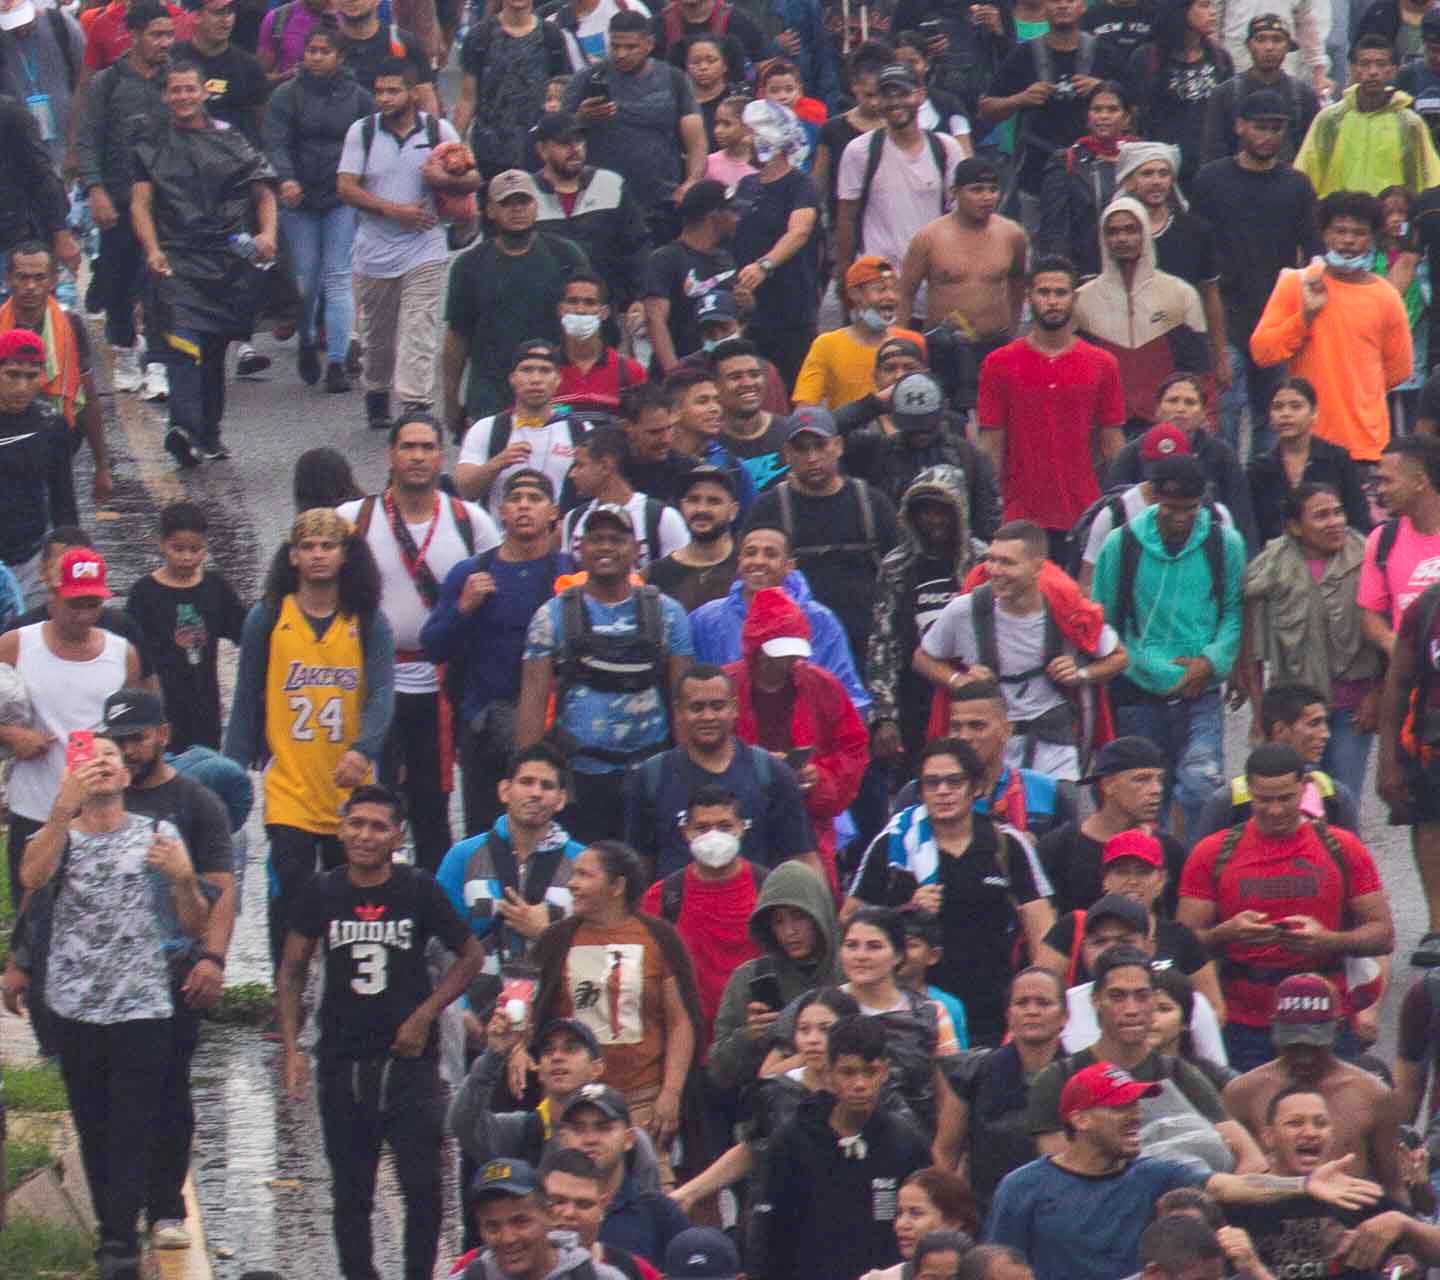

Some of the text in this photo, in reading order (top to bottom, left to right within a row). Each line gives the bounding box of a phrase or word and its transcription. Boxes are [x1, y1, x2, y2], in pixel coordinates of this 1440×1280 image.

[283, 660, 360, 692] LAKERS
[288, 696, 344, 742] 24
[329, 919, 415, 950] ADIDAS
[351, 947, 388, 995] 3
